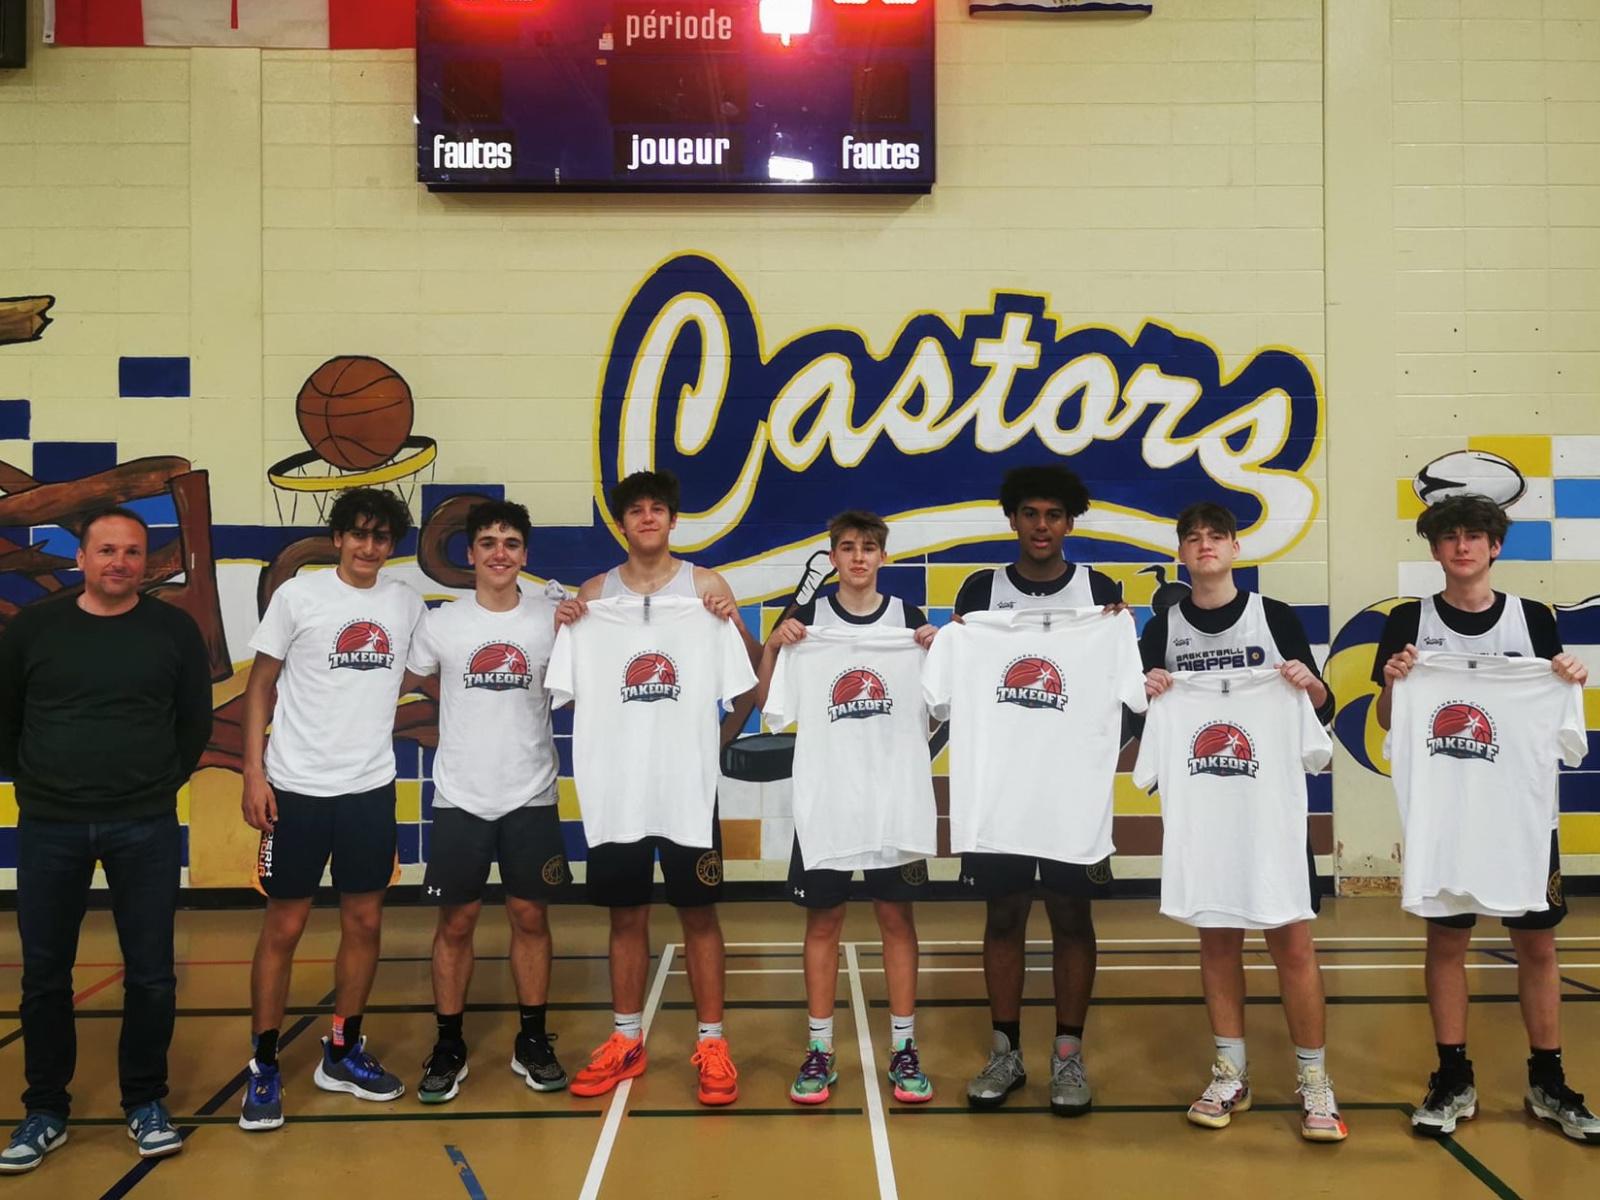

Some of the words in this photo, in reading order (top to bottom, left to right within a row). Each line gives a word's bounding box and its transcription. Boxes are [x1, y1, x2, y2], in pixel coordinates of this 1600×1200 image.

[626, 9, 732, 46] période
[433, 134, 513, 169] fautes
[627, 134, 731, 170] joueur
[842, 135, 920, 170] fautes
[606, 275, 1322, 558] Castors
[329, 653, 395, 669] TAKEOFF
[464, 673, 533, 689] TAKEOFF
[621, 682, 681, 702] TAKEOFF
[997, 687, 1068, 709] TAKEOFF
[828, 699, 893, 721] TAKEOFF
[1427, 737, 1500, 761] TAKEOFF
[1188, 757, 1260, 777] TAKEOFF
